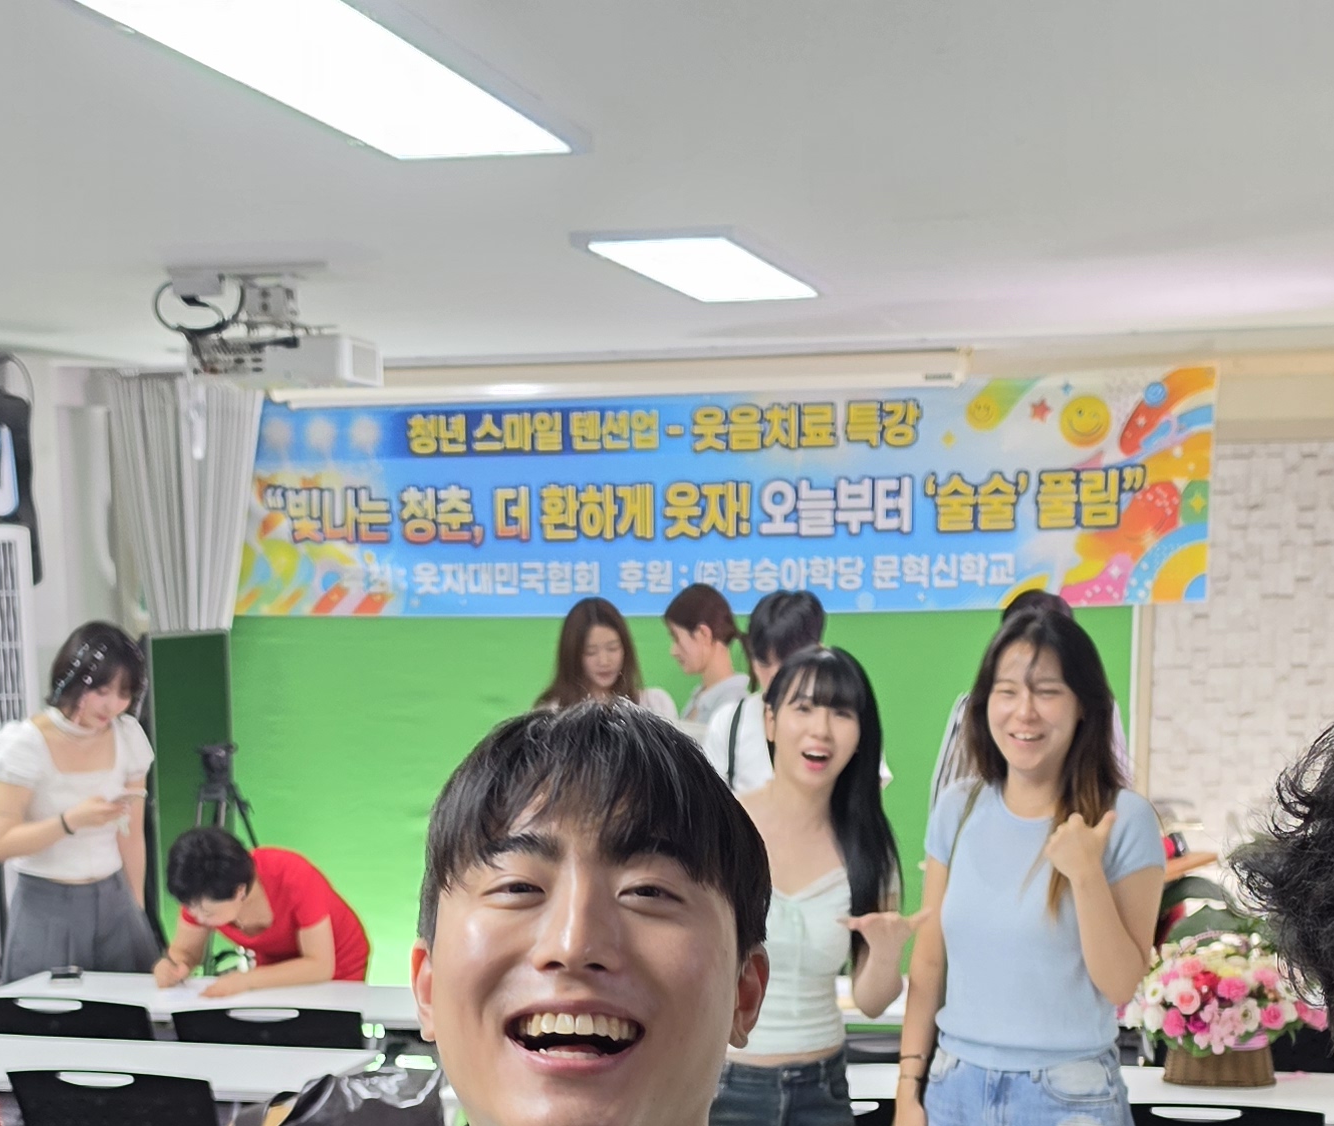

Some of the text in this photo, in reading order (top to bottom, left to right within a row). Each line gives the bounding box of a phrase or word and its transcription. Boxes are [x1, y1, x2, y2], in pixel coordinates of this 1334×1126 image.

[407, 412, 467, 455] 청년
[472, 410, 564, 453] 스마일
[691, 403, 839, 453] 웃음치료
[846, 399, 923, 449] 특강
[400, 484, 485, 547] 청춘,
[494, 484, 531, 543] 더
[540, 481, 654, 542] 환하게
[663, 480, 752, 540] 웃자!
[758, 476, 915, 537] 오늘부터
[618, 560, 673, 593] 후원
